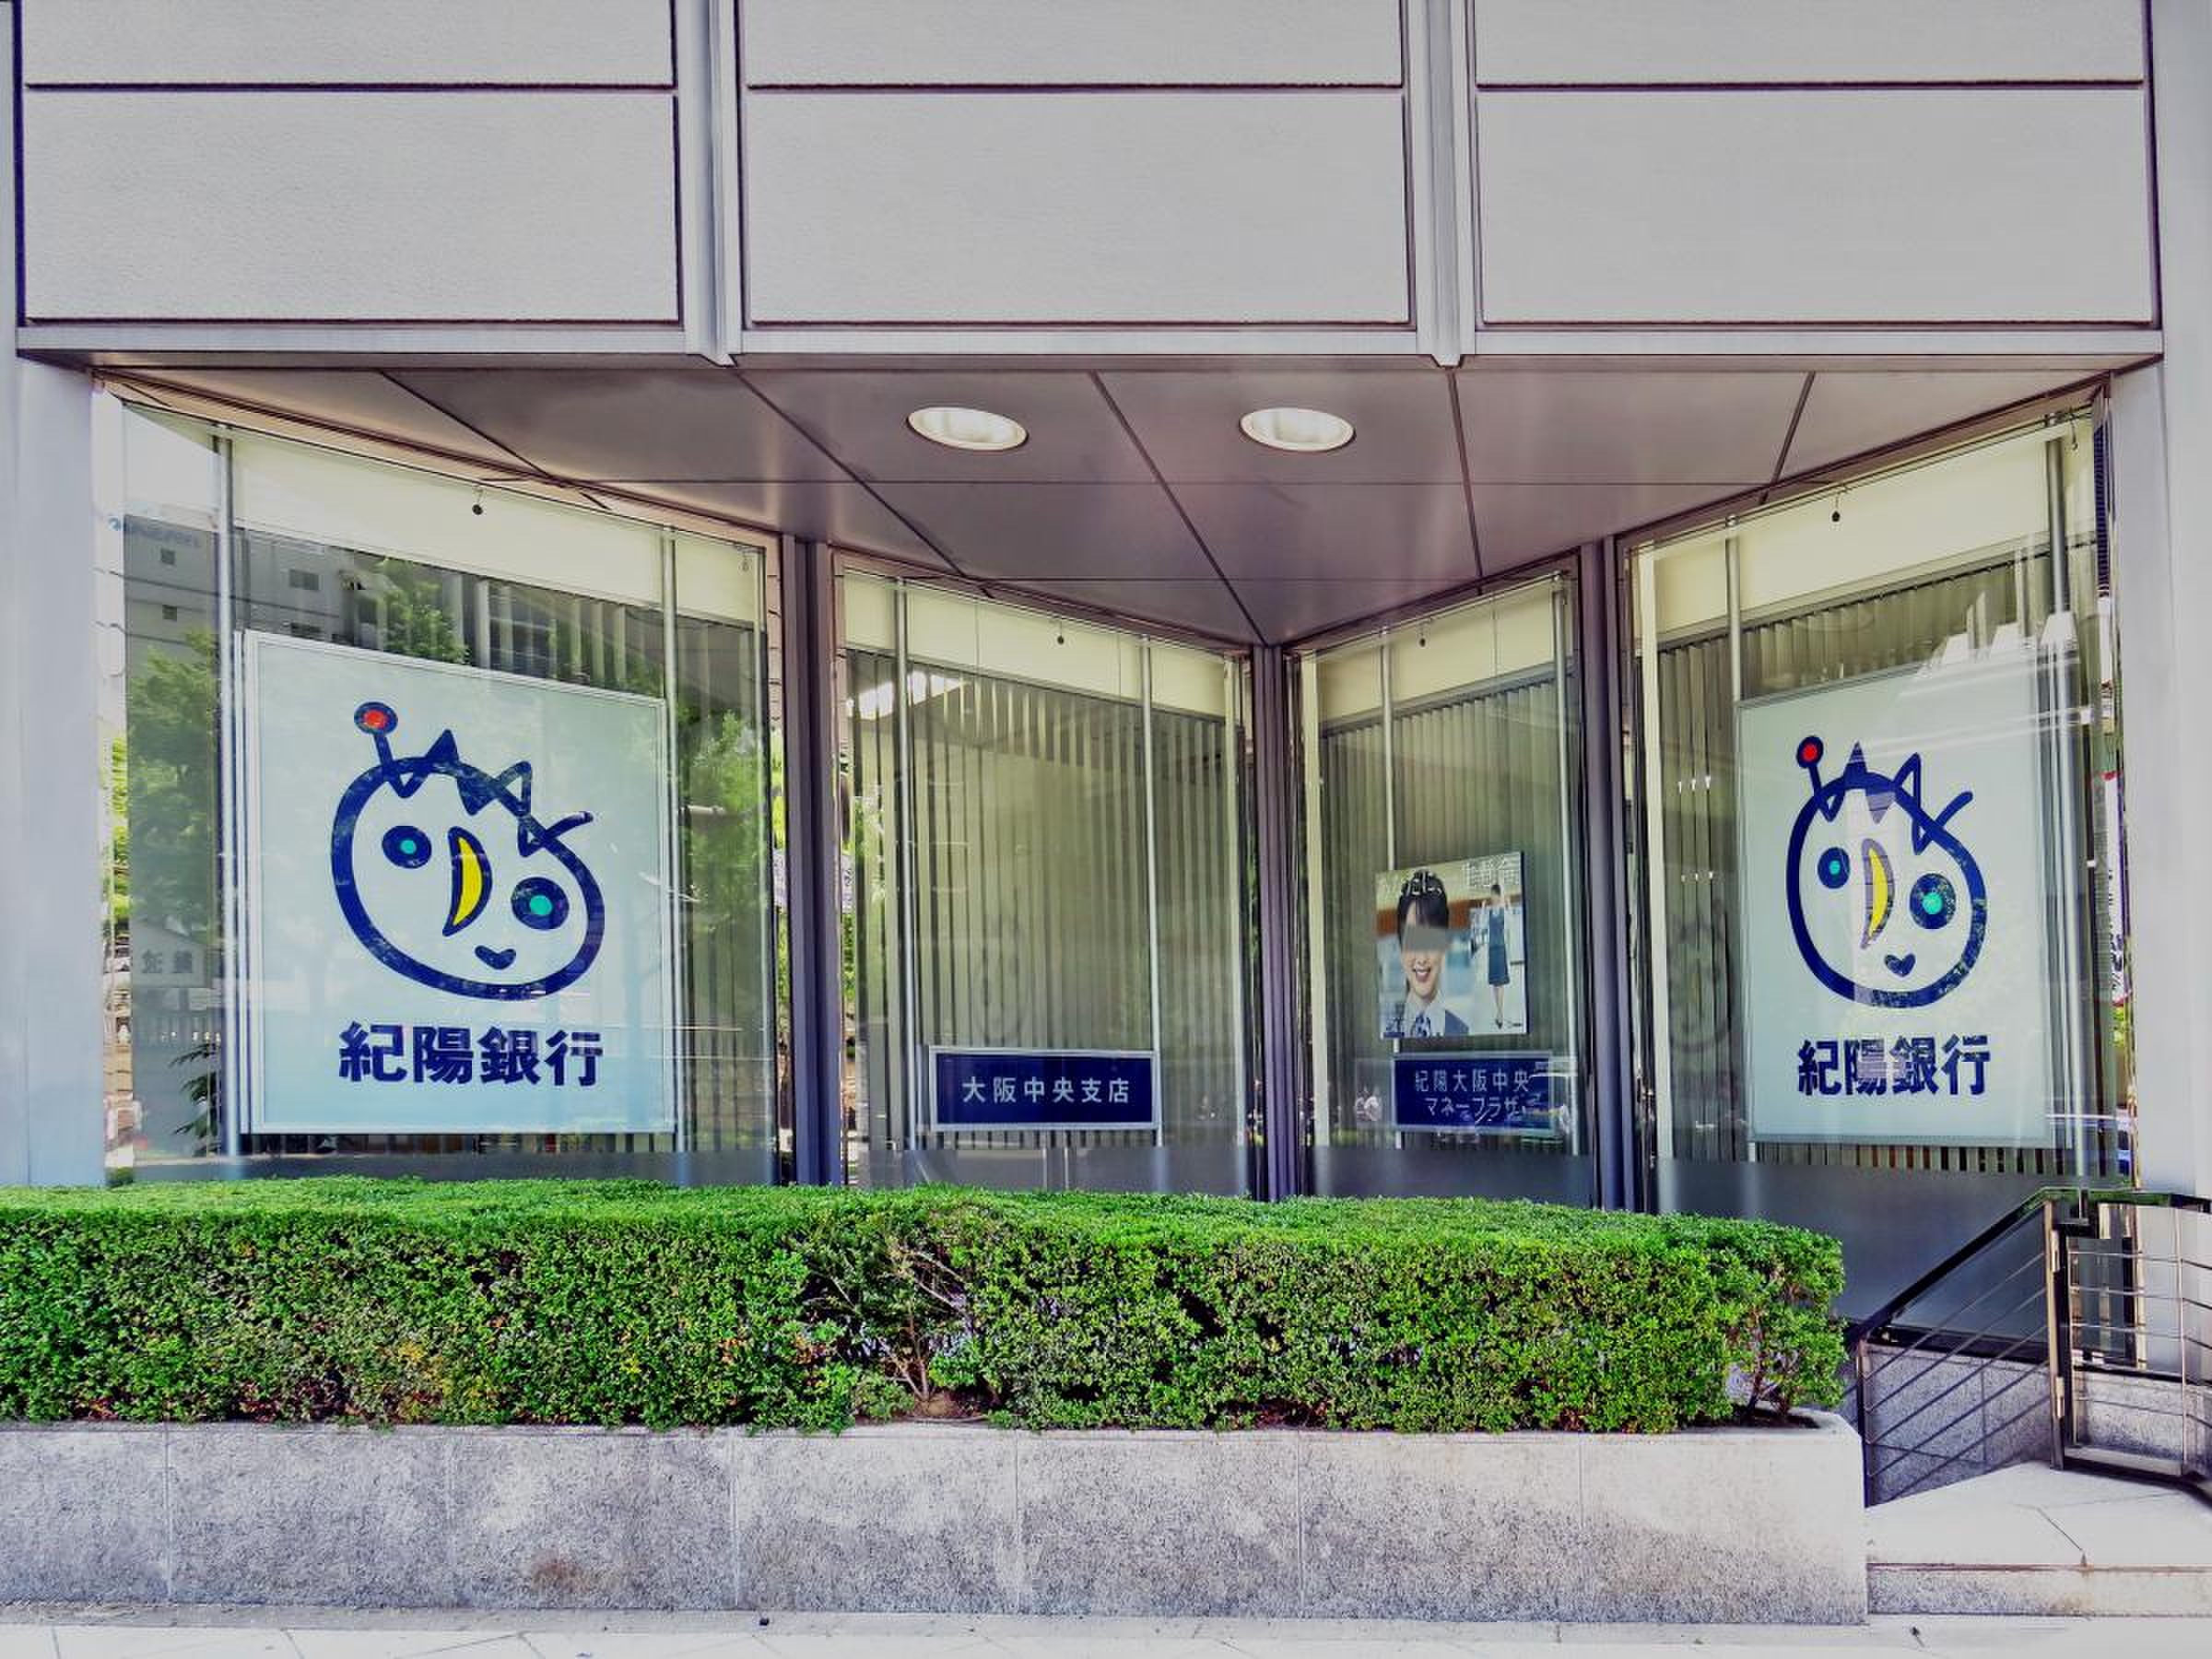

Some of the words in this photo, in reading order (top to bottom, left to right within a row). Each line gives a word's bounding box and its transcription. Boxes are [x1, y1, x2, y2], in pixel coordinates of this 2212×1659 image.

[339, 1020, 603, 1087] 紀陽銀行
[1798, 1034, 1991, 1096] 紀陽銀行
[962, 1076, 1129, 1103] 大阪中央支店
[1415, 1068, 1530, 1092] 紀陽大阪中央
